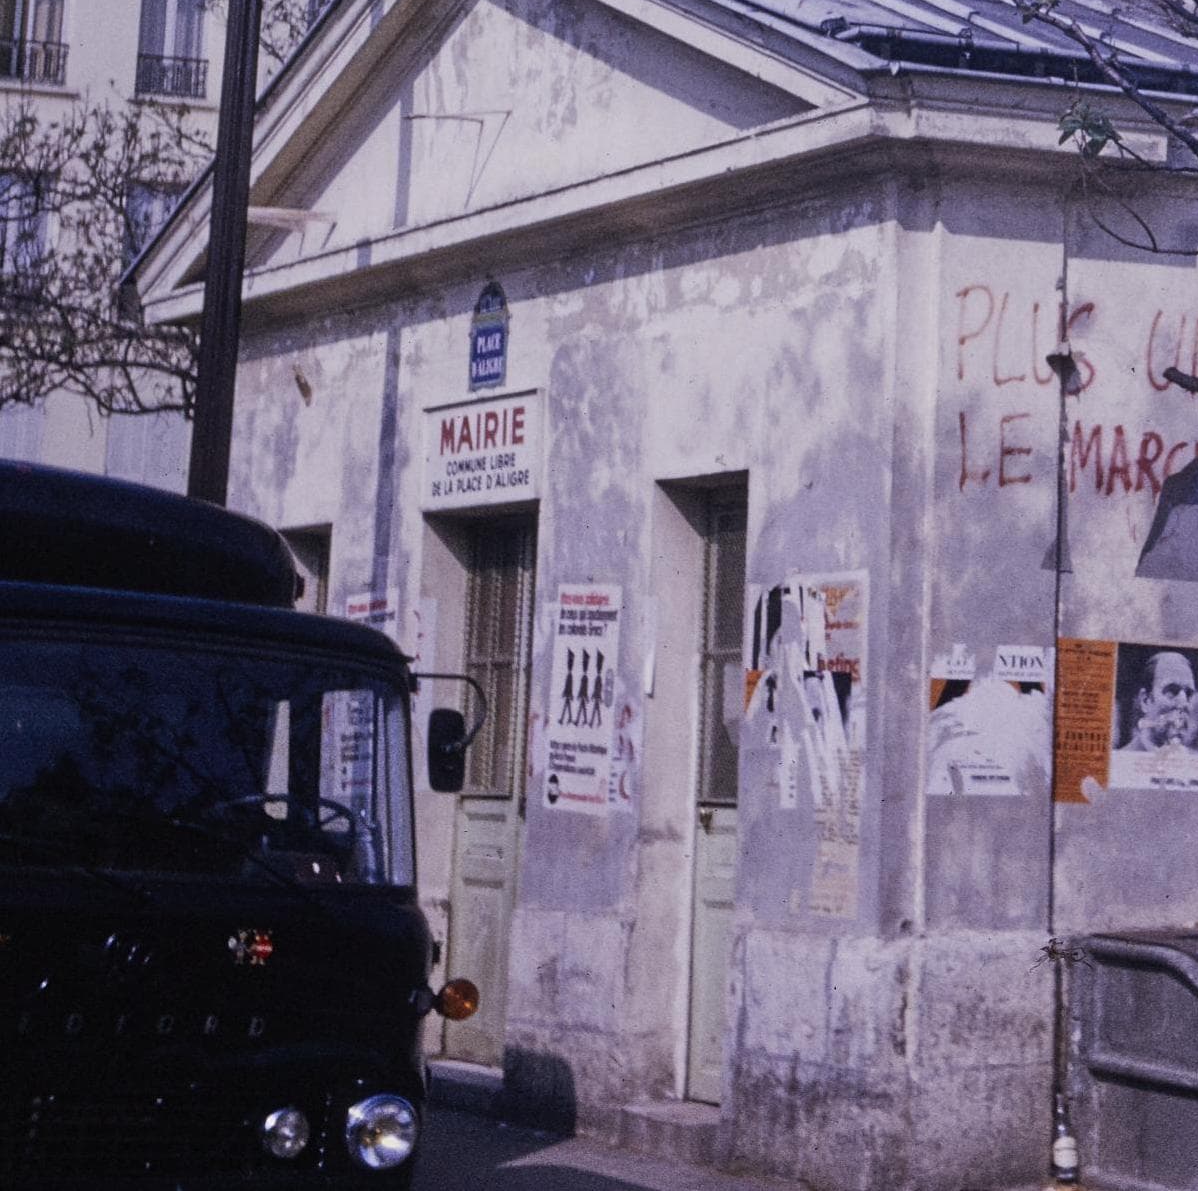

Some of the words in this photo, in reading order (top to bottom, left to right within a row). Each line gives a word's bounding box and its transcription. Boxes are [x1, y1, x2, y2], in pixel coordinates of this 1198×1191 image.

[477, 332, 502, 354] PLACE
[955, 285, 1096, 396] PLUS
[440, 406, 525, 455] MAIRIE
[446, 456, 487, 477] COMMUNE
[490, 452, 516, 471] LIBRE
[959, 411, 1032, 494] LE
[431, 480, 441, 497] DE
[444, 479, 453, 496] LA
[457, 475, 482, 494] PLACE
[486, 469, 530, 490] D'ALIGRE
